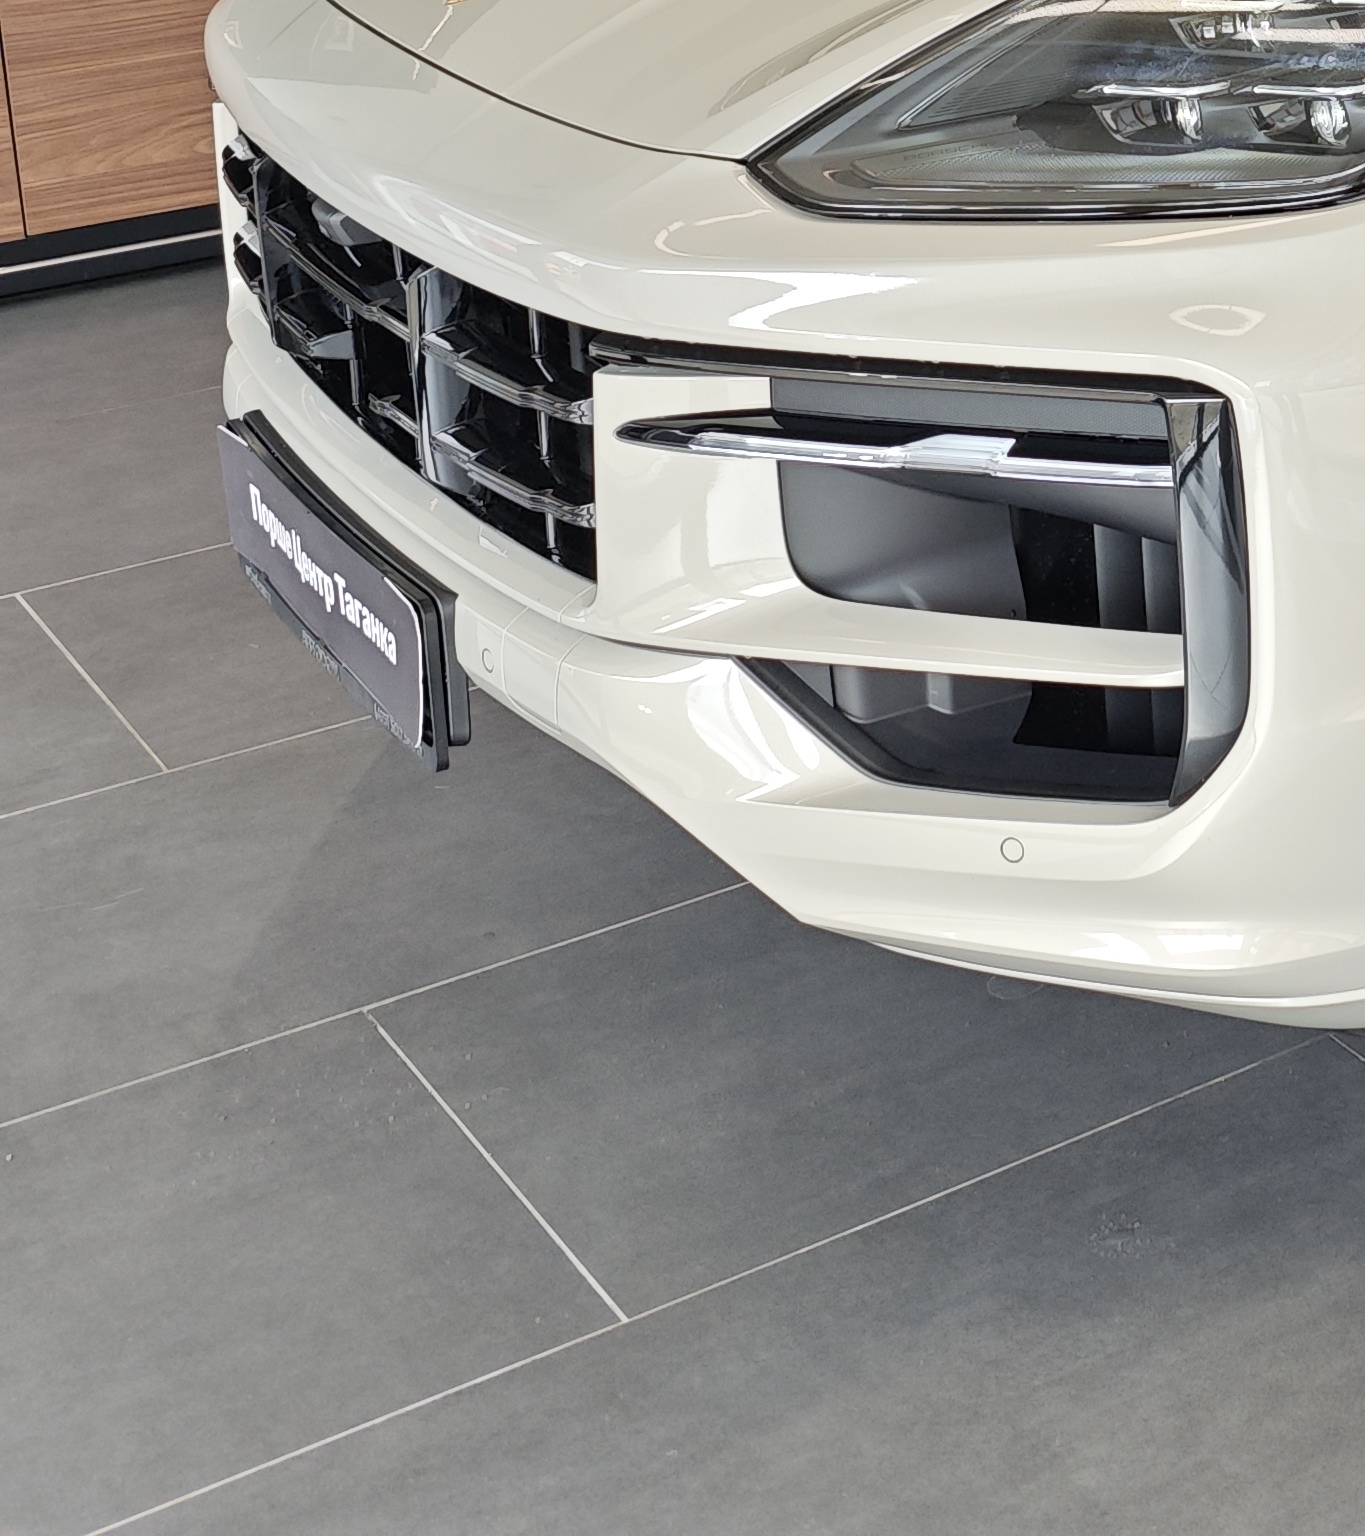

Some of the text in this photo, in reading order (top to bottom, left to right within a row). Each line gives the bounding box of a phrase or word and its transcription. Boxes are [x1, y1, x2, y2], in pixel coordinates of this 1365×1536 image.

[248, 482, 295, 561] Порше
[291, 528, 336, 613] Центр
[333, 571, 398, 666] Таганка
